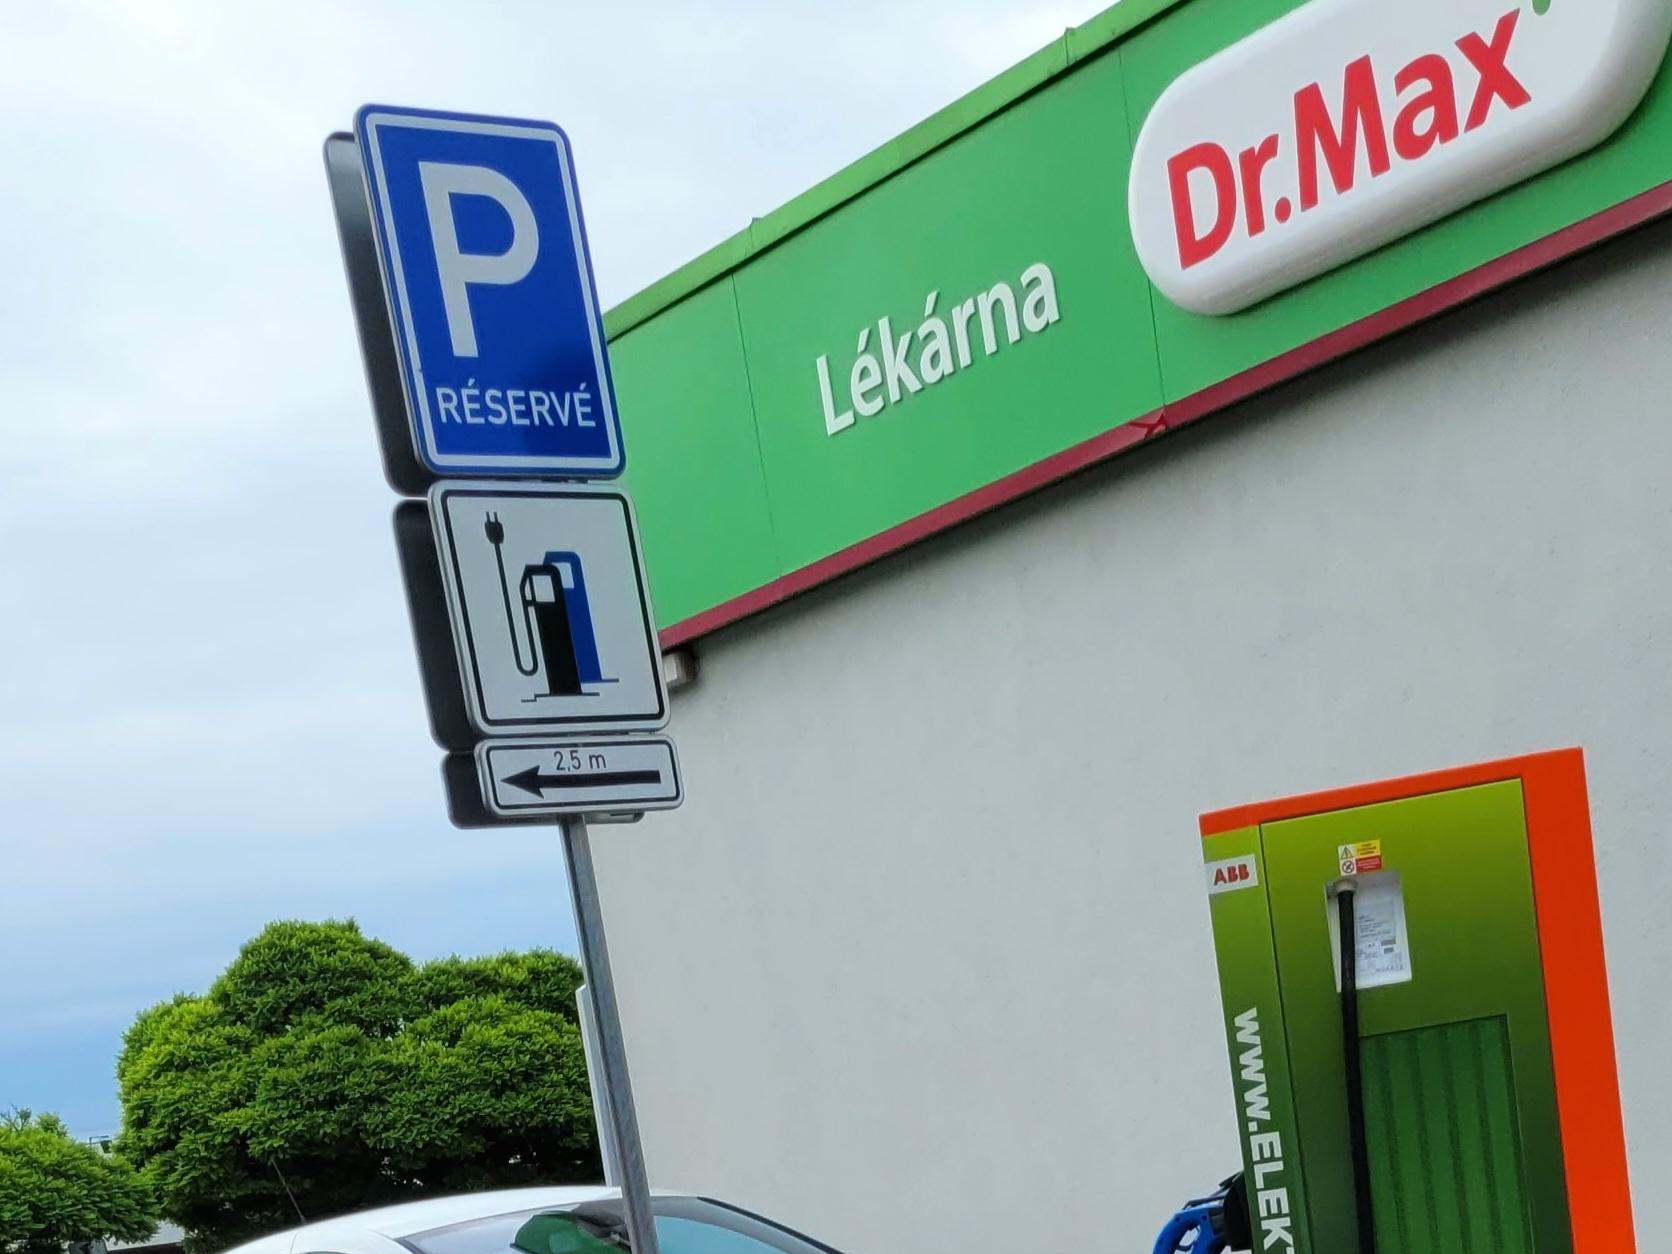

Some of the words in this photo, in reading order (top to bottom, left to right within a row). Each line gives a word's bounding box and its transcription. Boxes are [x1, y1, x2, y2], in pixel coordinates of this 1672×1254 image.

[1166, 8, 1532, 270] Dr.Max
[418, 161, 539, 358] P
[435, 377, 597, 428] RÉSERVÉ
[815, 262, 1060, 437] Lékárna
[553, 750, 581, 772] 2,5
[588, 752, 607, 770] m
[1213, 863, 1250, 886] ABB
